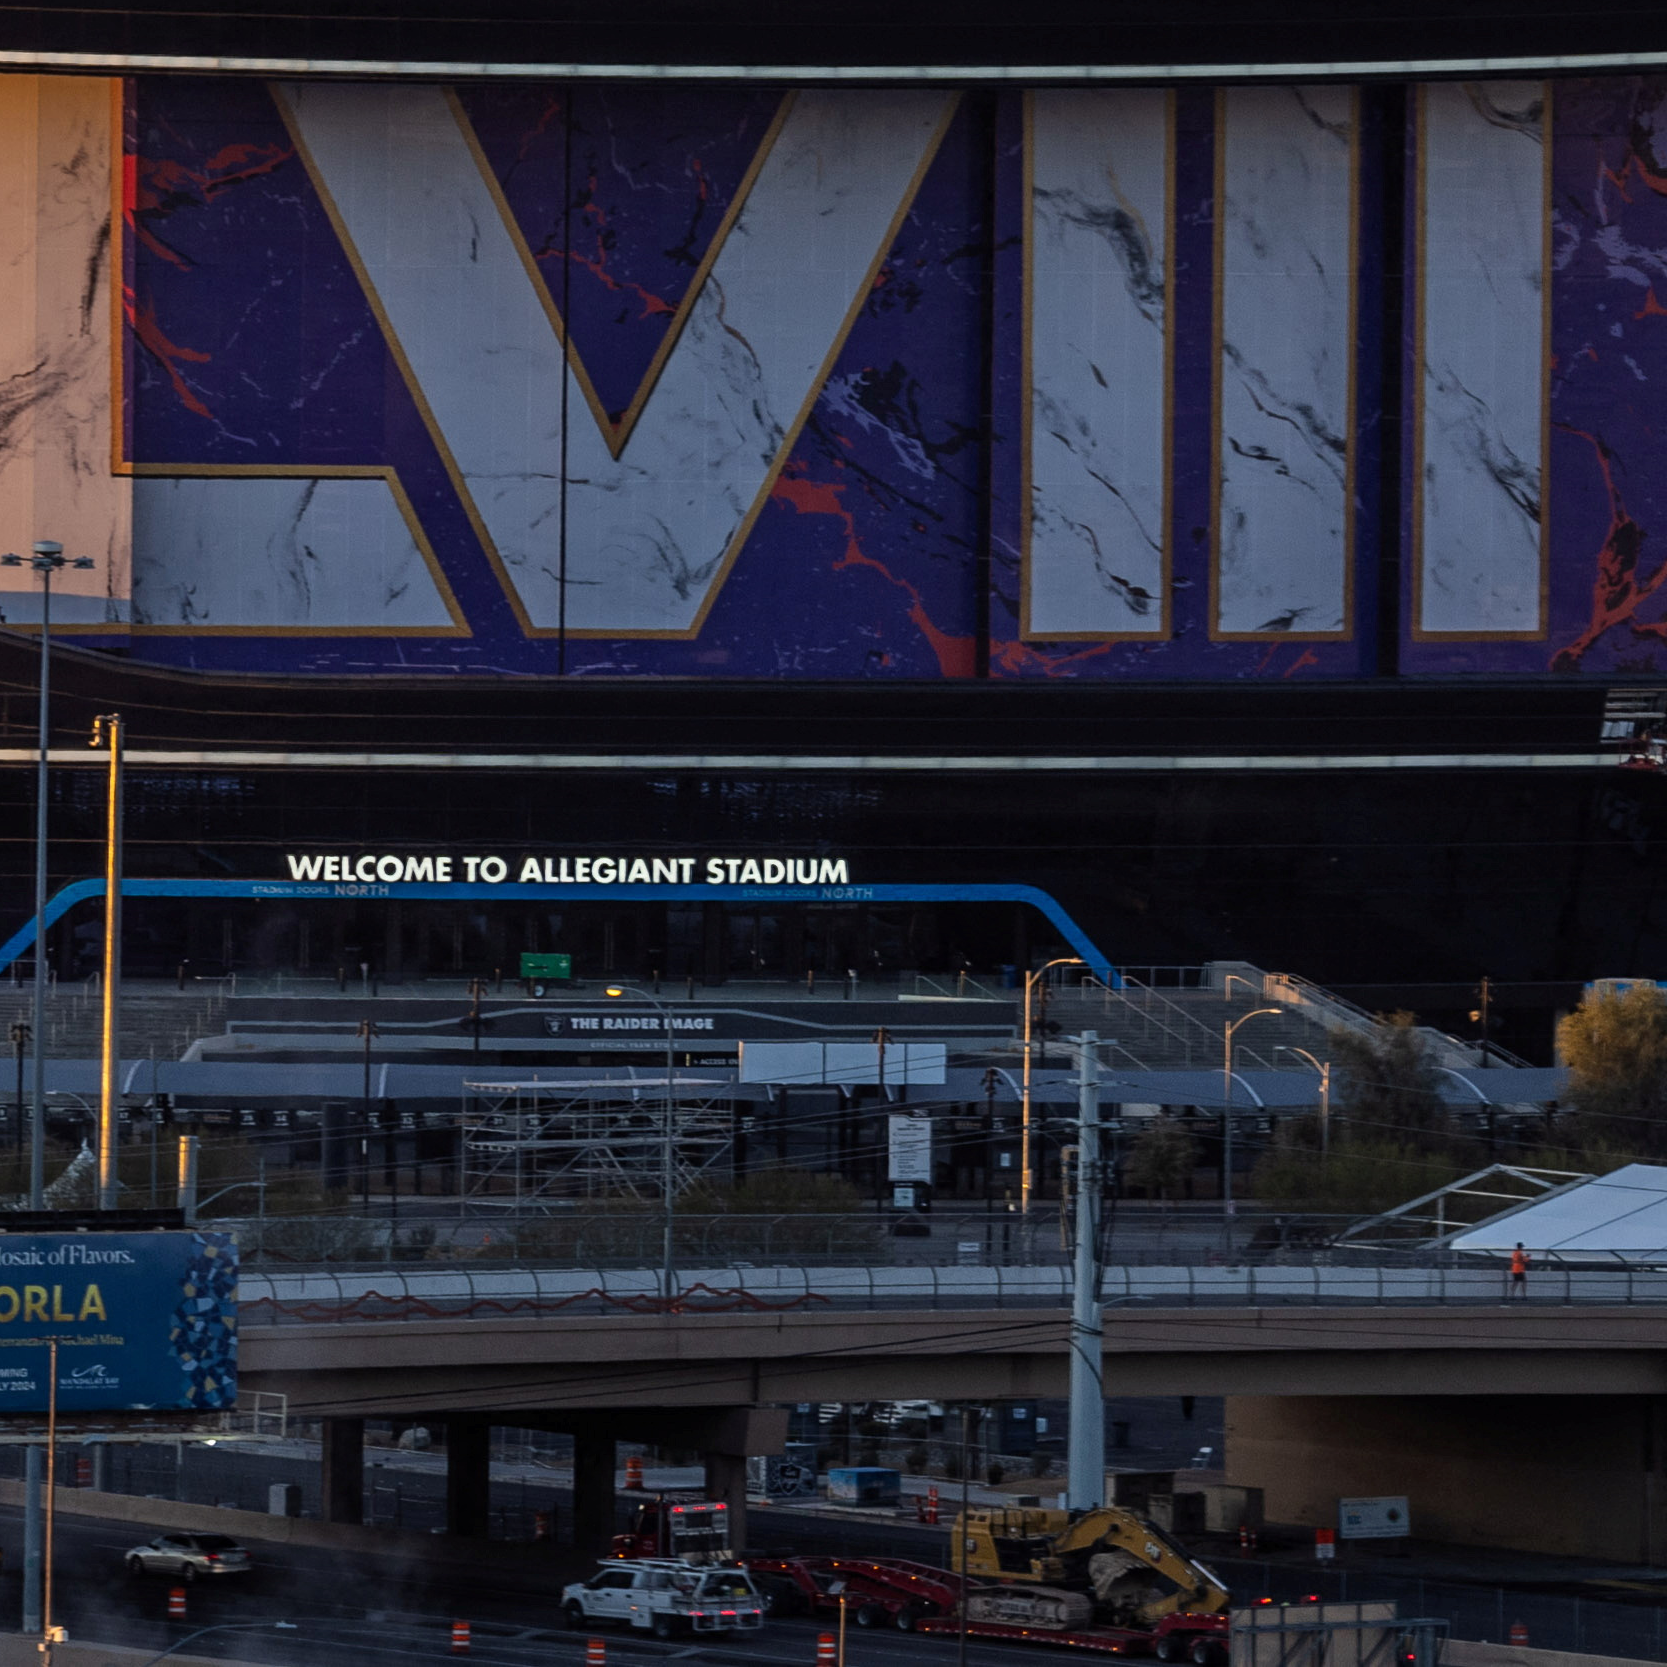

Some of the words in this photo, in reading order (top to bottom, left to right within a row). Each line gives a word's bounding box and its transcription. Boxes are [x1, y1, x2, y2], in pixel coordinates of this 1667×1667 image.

[286, 853, 453, 883] WELCOME
[462, 855, 508, 884] TO
[519, 855, 696, 885] ALLEGIANT
[704, 856, 850, 886] STADIUM
[334, 884, 390, 896] NORTH
[821, 887, 874, 899] NORTH
[570, 1017, 601, 1030] THE
[603, 1017, 660, 1030] RAIDER
[48, 1244, 67, 1266] of
[68, 1244, 136, 1266] Flavors.
[10, 1381, 36, 1391] 2024
